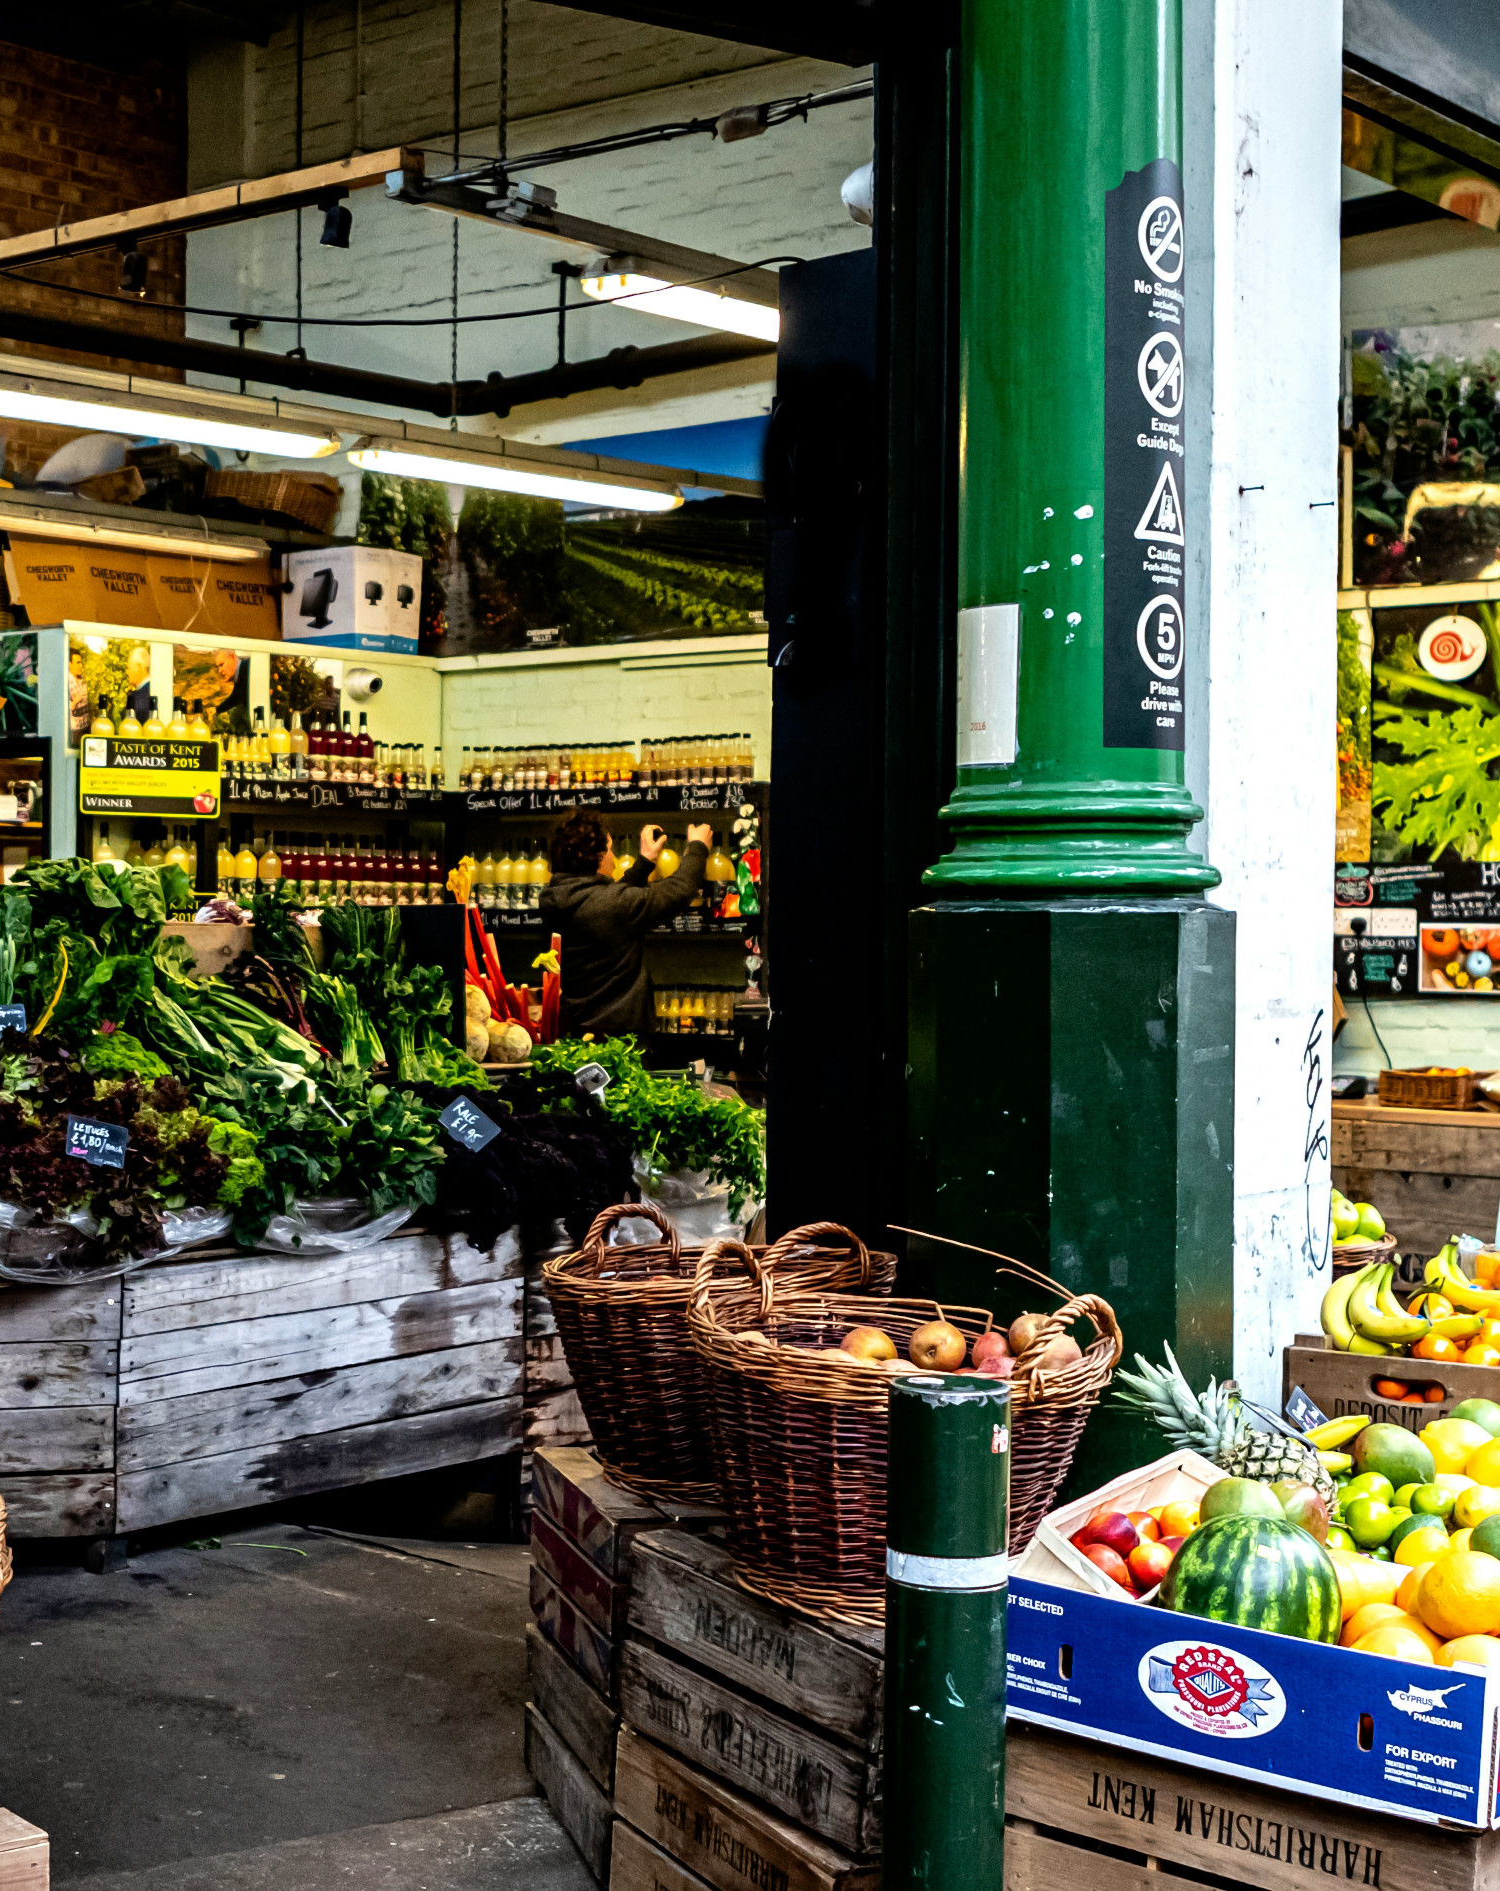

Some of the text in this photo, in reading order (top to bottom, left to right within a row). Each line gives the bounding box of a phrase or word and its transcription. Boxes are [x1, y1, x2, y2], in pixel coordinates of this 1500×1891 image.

[1134, 279, 1152, 294] No
[1151, 418, 1179, 437] Except
[1136, 433, 1168, 451] Guide
[1148, 545, 1181, 563] Caution
[26, 564, 75, 574] CHEGWORTH
[90, 566, 147, 585] CHEGWORTH
[37, 573, 68, 582] VALLEY
[103, 580, 139, 596] VALLEY
[228, 591, 264, 606] VALLEY
[1157, 612, 1176, 651] 5
[1157, 653, 1175, 664] MPH
[1149, 681, 1179, 697] Please
[1141, 696, 1167, 712] drive
[970, 722, 986, 732] 2016
[1156, 715, 1176, 728] care
[112, 741, 203, 756] TASTE OF KENT
[114, 754, 200, 768] AWARDS 2015
[85, 796, 133, 808] WINNER
[311, 784, 344, 808] DEAL
[500, 795, 523, 809] Offer
[452, 1100, 480, 1125] KALE
[73, 1121, 110, 1137] LETTUCES
[1018, 1597, 1064, 1616] SELECTED
[696, 1602, 796, 1681] MARDEN
[1022, 1657, 1046, 1669] CHOIX
[1179, 1651, 1240, 1683] RED SEAL
[1197, 1661, 1222, 1672] BRAND
[1193, 1672, 1226, 1695] QUALITY
[1177, 1679, 1206, 1711] PHASSOURI
[1399, 1693, 1434, 1707] CYPRUS
[1413, 1712, 1463, 1731] PHASSOURI
[1386, 1743, 1457, 1770] FOR EXPORT
[654, 1782, 687, 1832] KENT
[1088, 1771, 1382, 1887] KENT HARRIETSHAM
